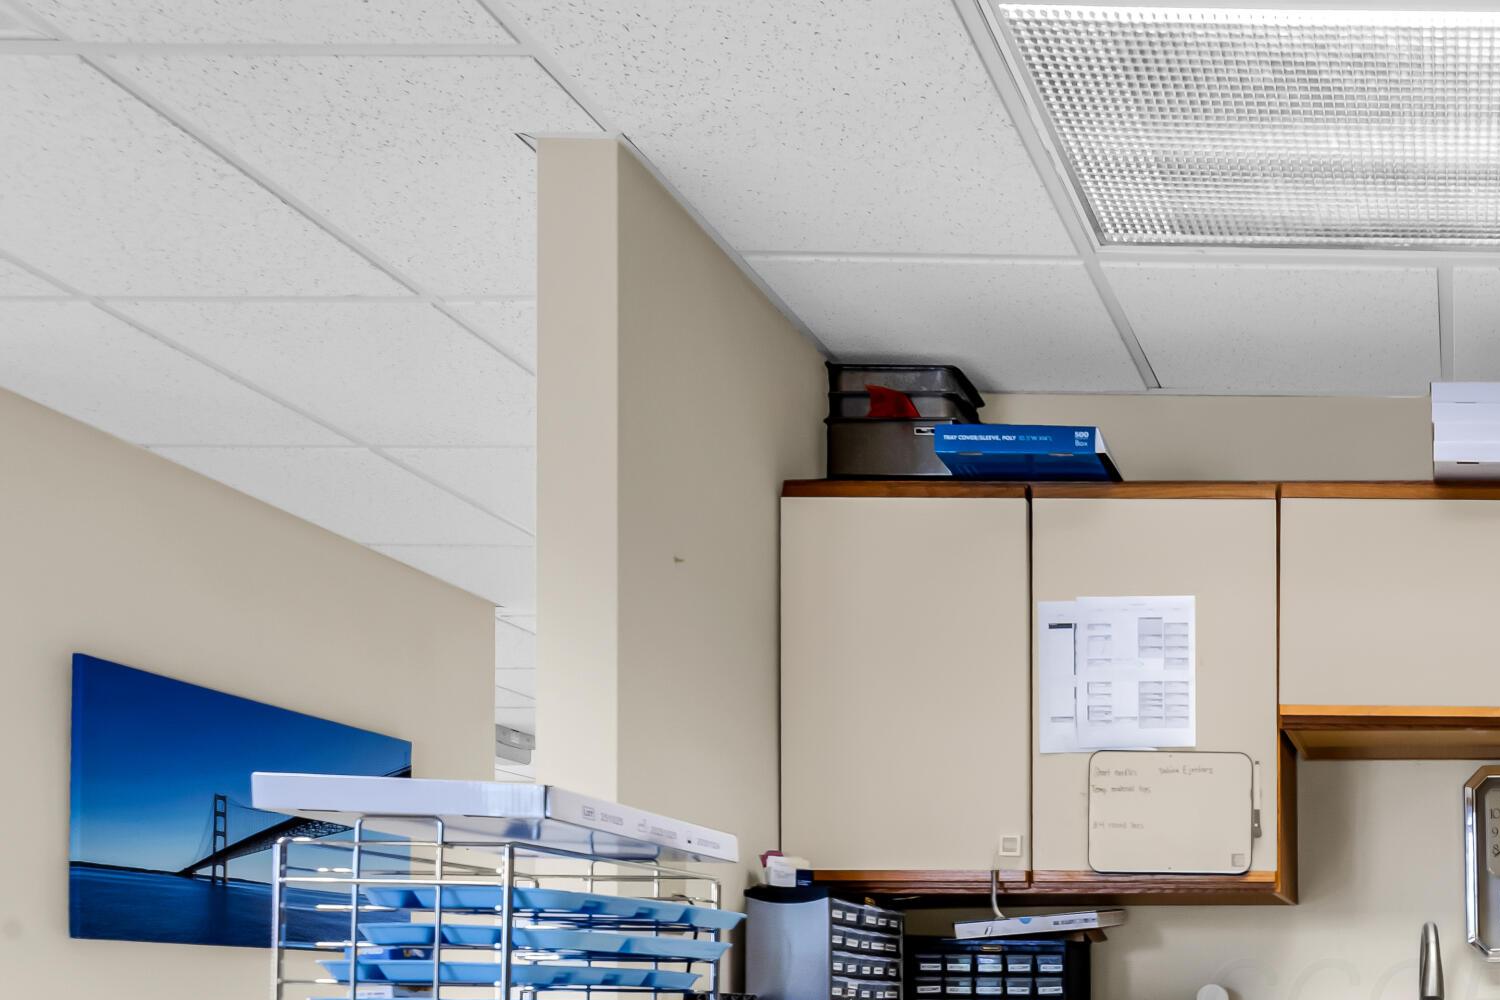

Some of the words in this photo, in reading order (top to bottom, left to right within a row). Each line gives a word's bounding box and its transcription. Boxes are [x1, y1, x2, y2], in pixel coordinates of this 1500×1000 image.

[1074, 431, 1090, 439] 500
[1075, 439, 1089, 447] Box
[1490, 808, 1500, 819] 10
[1491, 826, 1499, 837] 9
